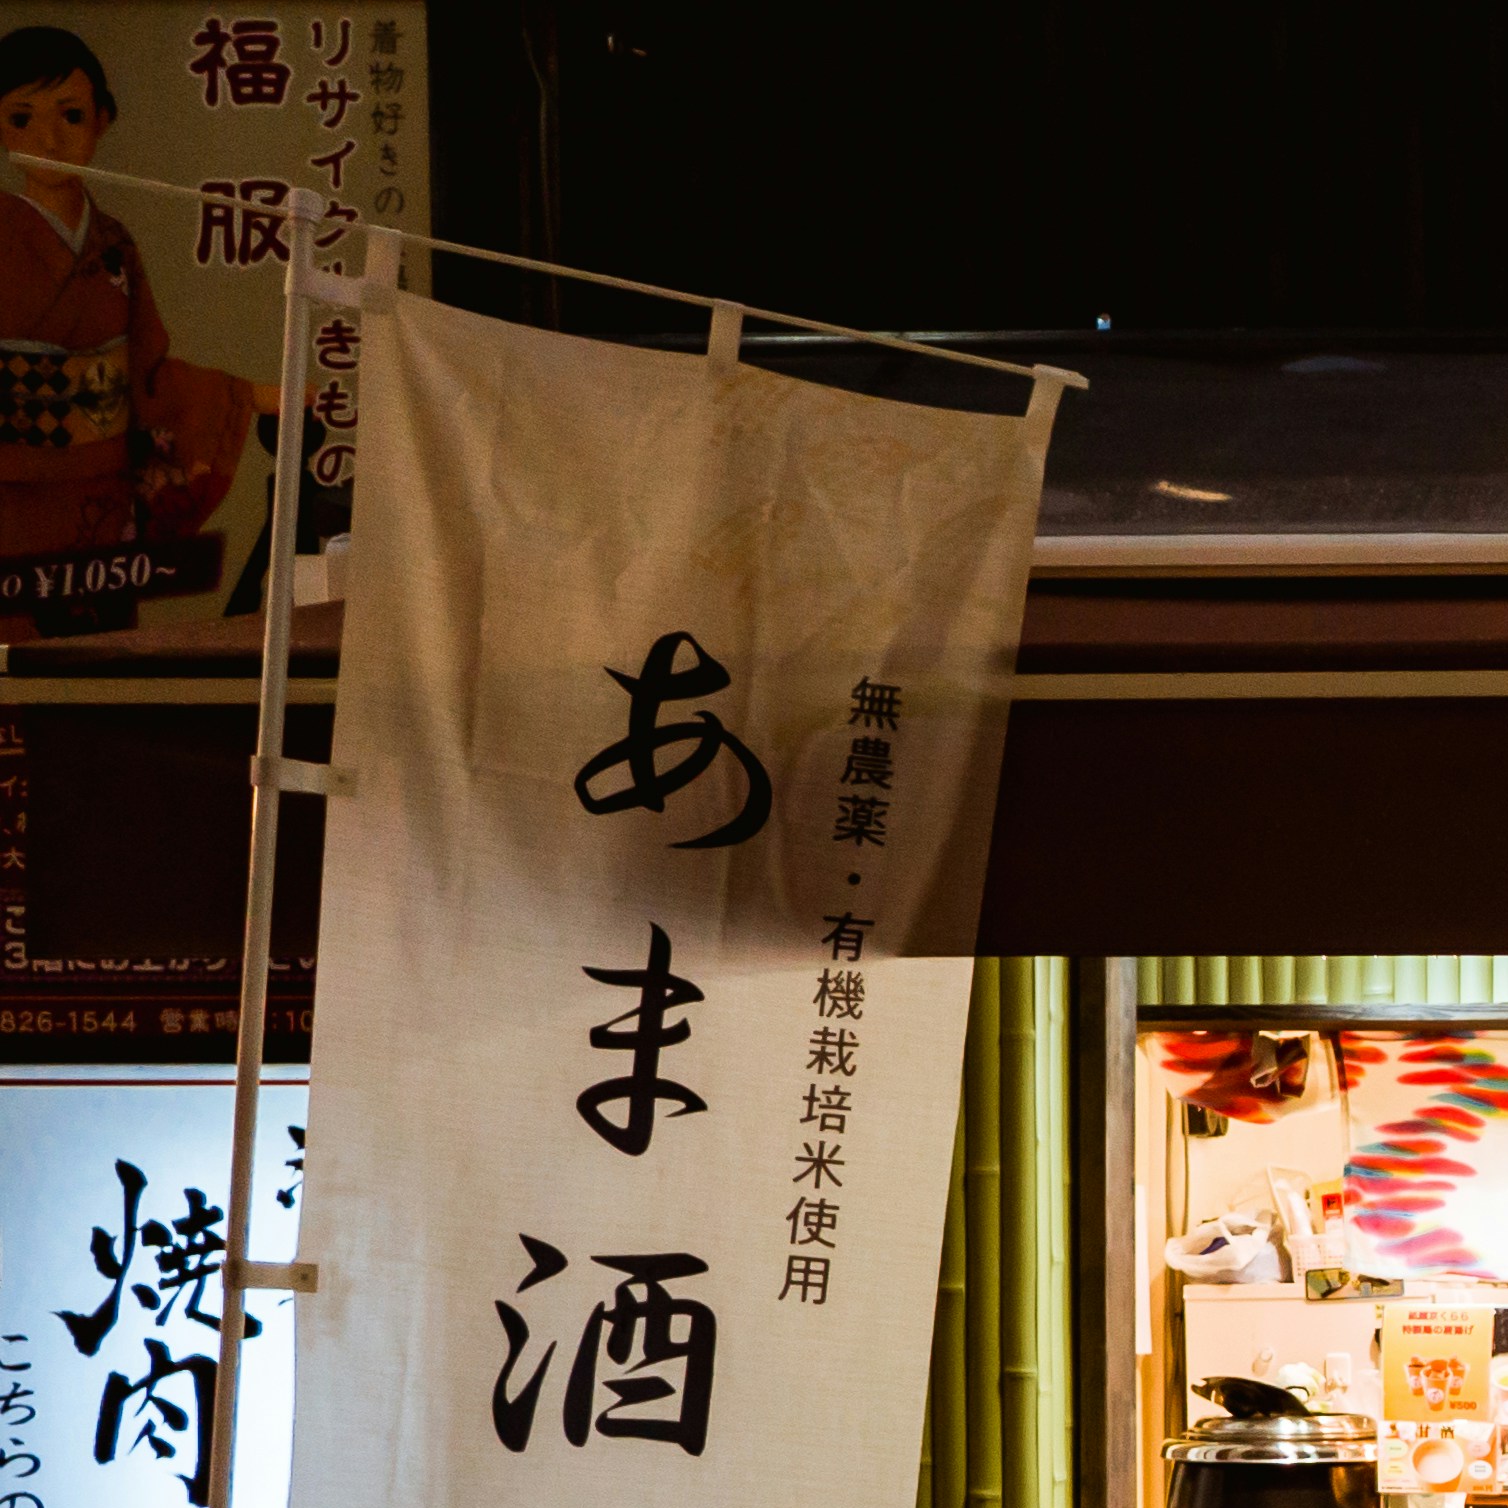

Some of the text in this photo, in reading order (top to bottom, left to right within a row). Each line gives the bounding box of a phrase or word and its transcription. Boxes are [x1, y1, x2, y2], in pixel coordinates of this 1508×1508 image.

[306, 18, 362, 486] リサイクきもの
[490, 630, 774, 1458] あま酒
[777, 675, 904, 1308] 無農薬・有機栽培米使用
